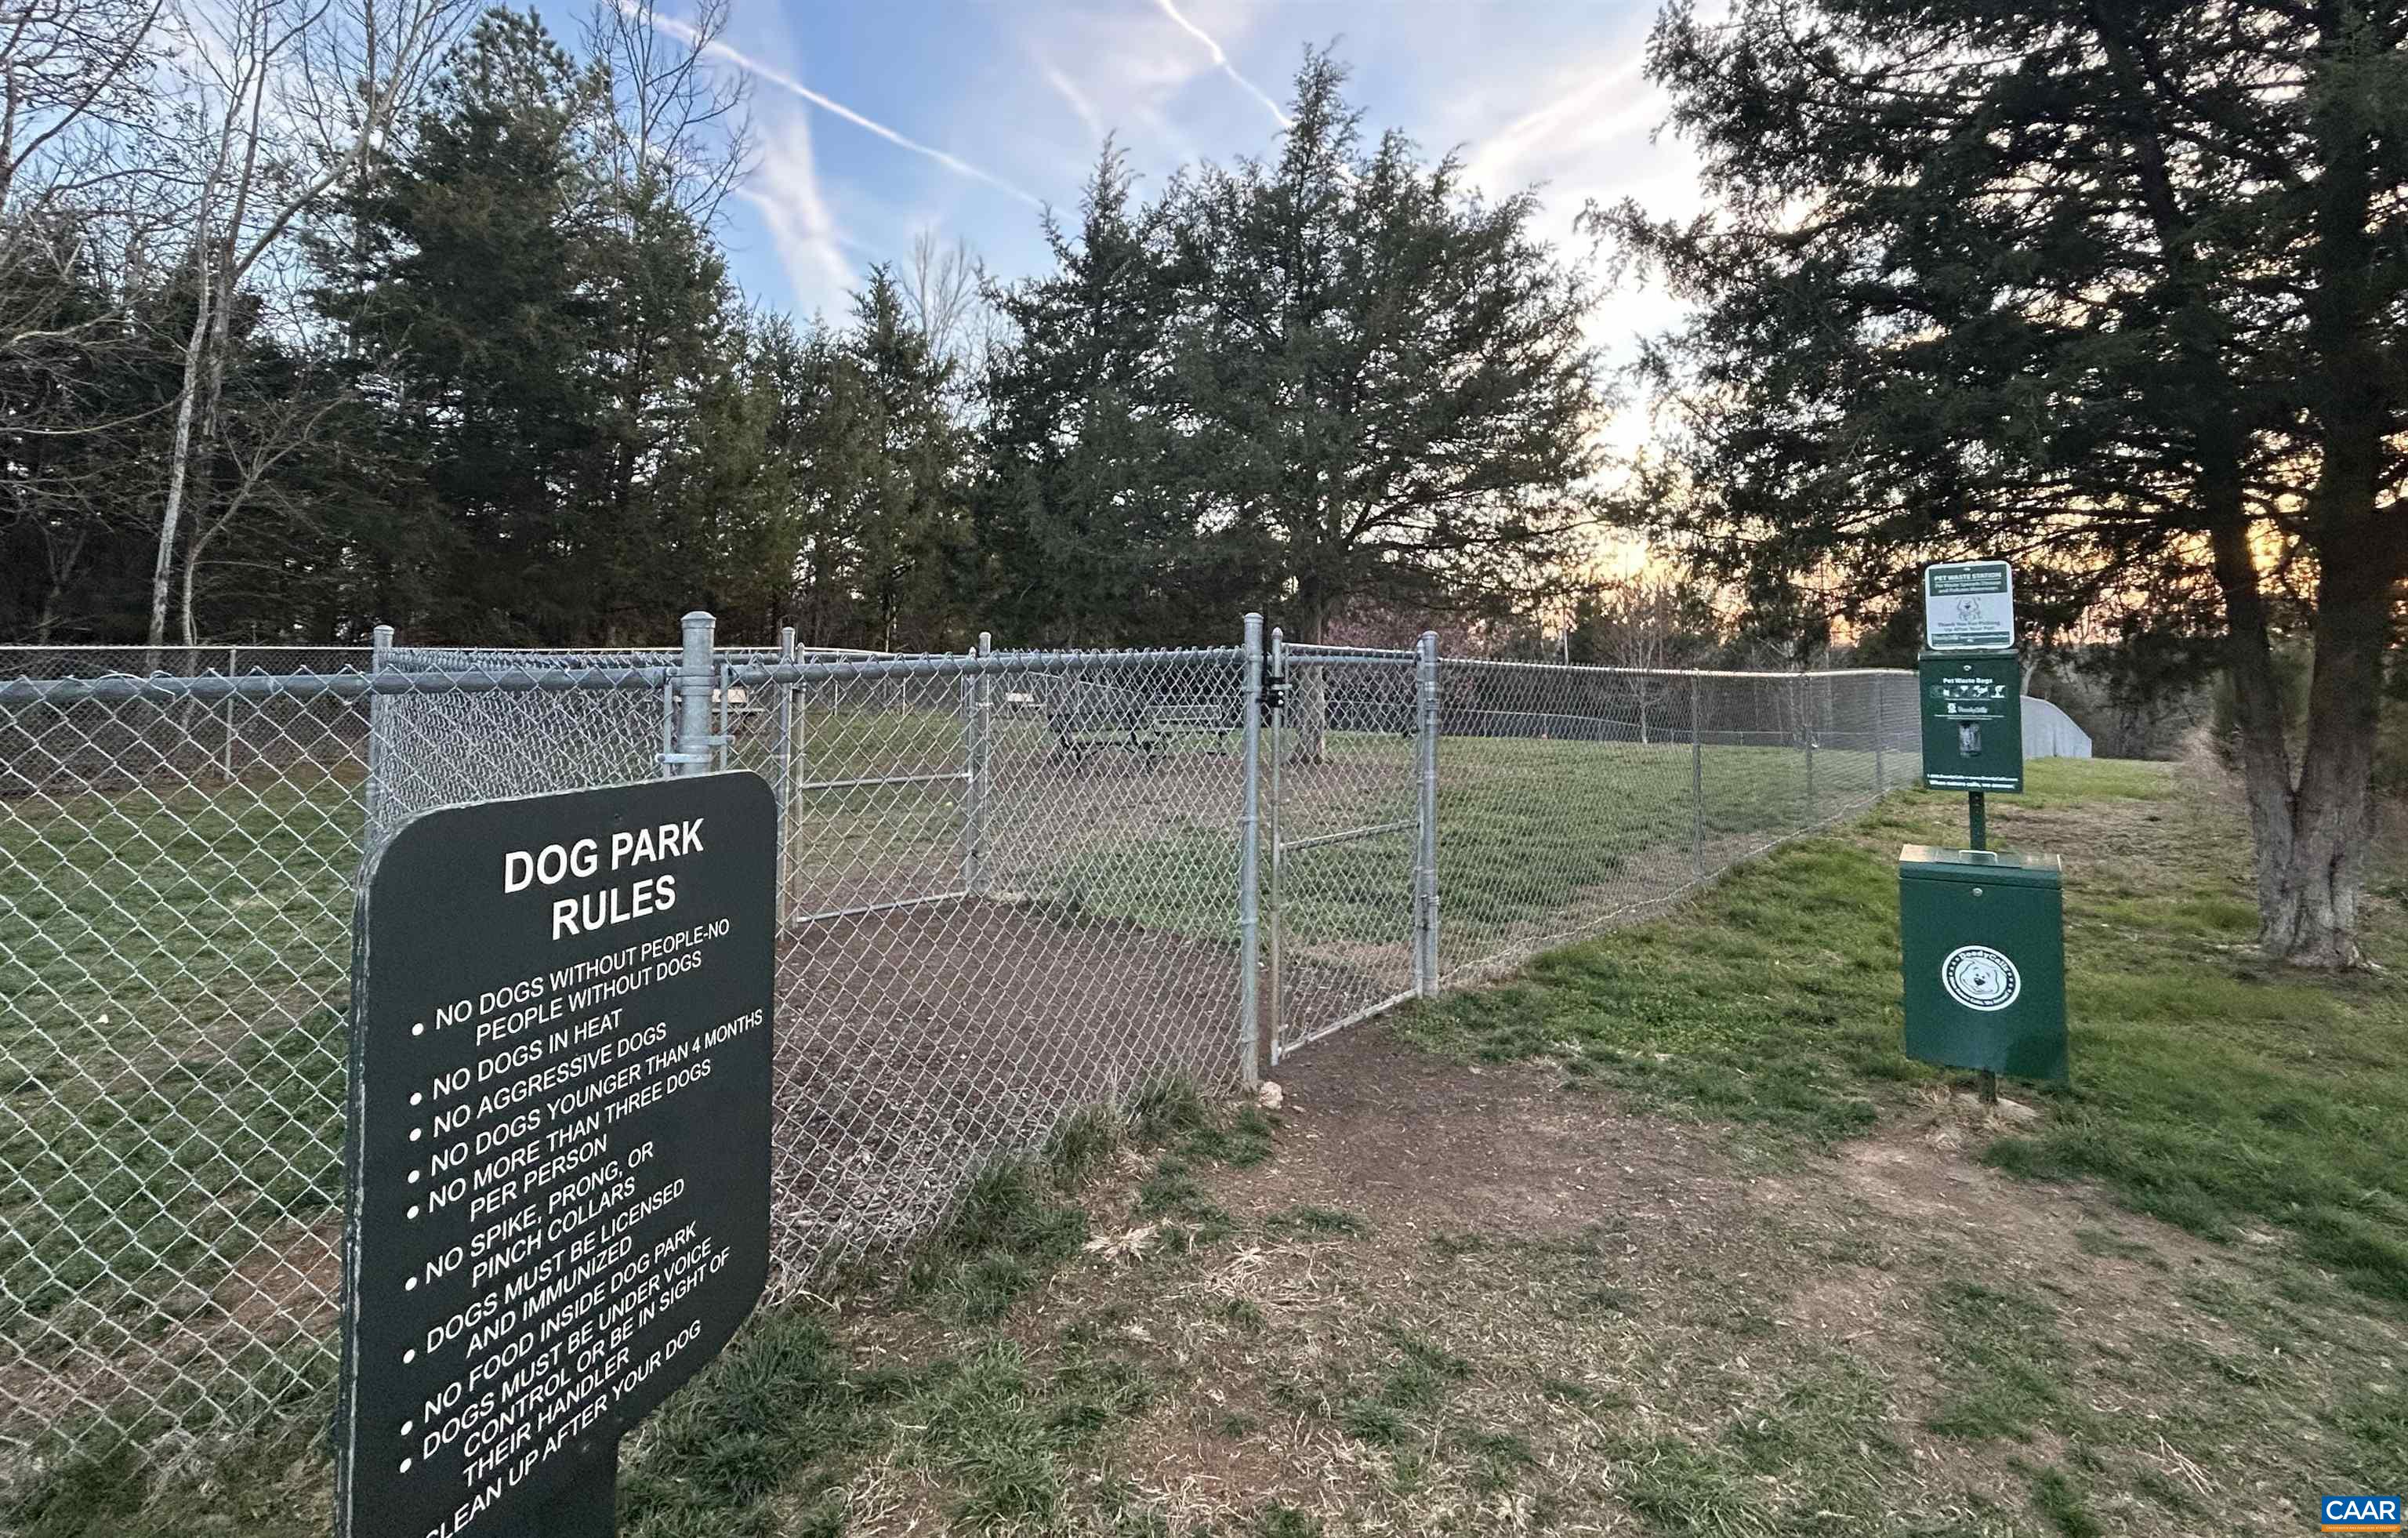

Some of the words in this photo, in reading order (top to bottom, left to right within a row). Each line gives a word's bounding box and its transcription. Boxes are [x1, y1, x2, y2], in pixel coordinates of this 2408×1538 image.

[504, 838, 598, 894] DOG
[611, 818, 705, 871] PARK
[552, 874, 676, 941] RULES
[435, 999, 473, 1030] NO
[480, 976, 544, 1015] DOGS
[549, 946, 637, 992] WITHOUT
[641, 918, 730, 962] PEOPLE-NO
[476, 997, 564, 1046] PEOPLE
[568, 966, 653, 1012] WITHOUT
[656, 950, 702, 981] DOGS
[431, 1141, 469, 1177] NO
[476, 1108, 541, 1155] DOGS
[546, 1063, 642, 1120] YOUNGER
[644, 1041, 688, 1076] THAN
[691, 1036, 702, 1054] 4
[704, 1008, 763, 1050] MONTHS
[433, 1067, 471, 1101] NO
[477, 1039, 543, 1083] DOGS
[549, 1028, 568, 1054] IN
[574, 1007, 623, 1044] HEAT
[433, 1104, 471, 1138] NO
[476, 1043, 612, 1119] AGGRESSIVE
[617, 1021, 667, 1058] DOGS
[429, 1177, 466, 1213] NO
[473, 1139, 540, 1191] MORE
[546, 1111, 600, 1152] THAN
[604, 1080, 662, 1124] THREE
[666, 1058, 711, 1094] DOGS
[470, 1181, 518, 1223] PER
[523, 1133, 607, 1194] PERSON
[426, 1246, 464, 1285] NO
[470, 1203, 542, 1257] SPIKE,
[548, 1160, 623, 1215] PRONG,
[628, 1141, 654, 1169] OR
[426, 1292, 498, 1354] DOGS
[504, 1249, 566, 1304] MUST
[570, 1230, 597, 1263] BE
[600, 1178, 685, 1244] LICENSED
[472, 1228, 542, 1289] PINCH
[547, 1176, 635, 1242] COLLARS
[423, 1391, 495, 1460] DOGS
[501, 1341, 563, 1403] MUST
[568, 1319, 593, 1355] BE
[599, 1274, 661, 1331] UNDER
[663, 1236, 712, 1283] VOICE
[424, 1381, 462, 1424] NO
[469, 1332, 535, 1392] FOOD
[540, 1281, 606, 1343] INSIDE
[611, 1253, 650, 1294] DOG
[654, 1220, 696, 1264] PARK
[463, 1367, 571, 1458] CONTROL
[576, 1339, 605, 1373] OR
[610, 1316, 633, 1350] BE
[639, 1300, 655, 1328] IN
[659, 1263, 707, 1311] SIGHT
[709, 1246, 731, 1274] OF
[466, 1310, 517, 1359] AND
[522, 1235, 633, 1322] IMMUNIZED
[462, 1422, 531, 1488] THEIR
[537, 1346, 629, 1433] HANDLER
[509, 1449, 539, 1486] UP
[542, 1394, 607, 1462] AFTER
[611, 1350, 662, 1402] YOUR
[665, 1319, 701, 1361] DOG
